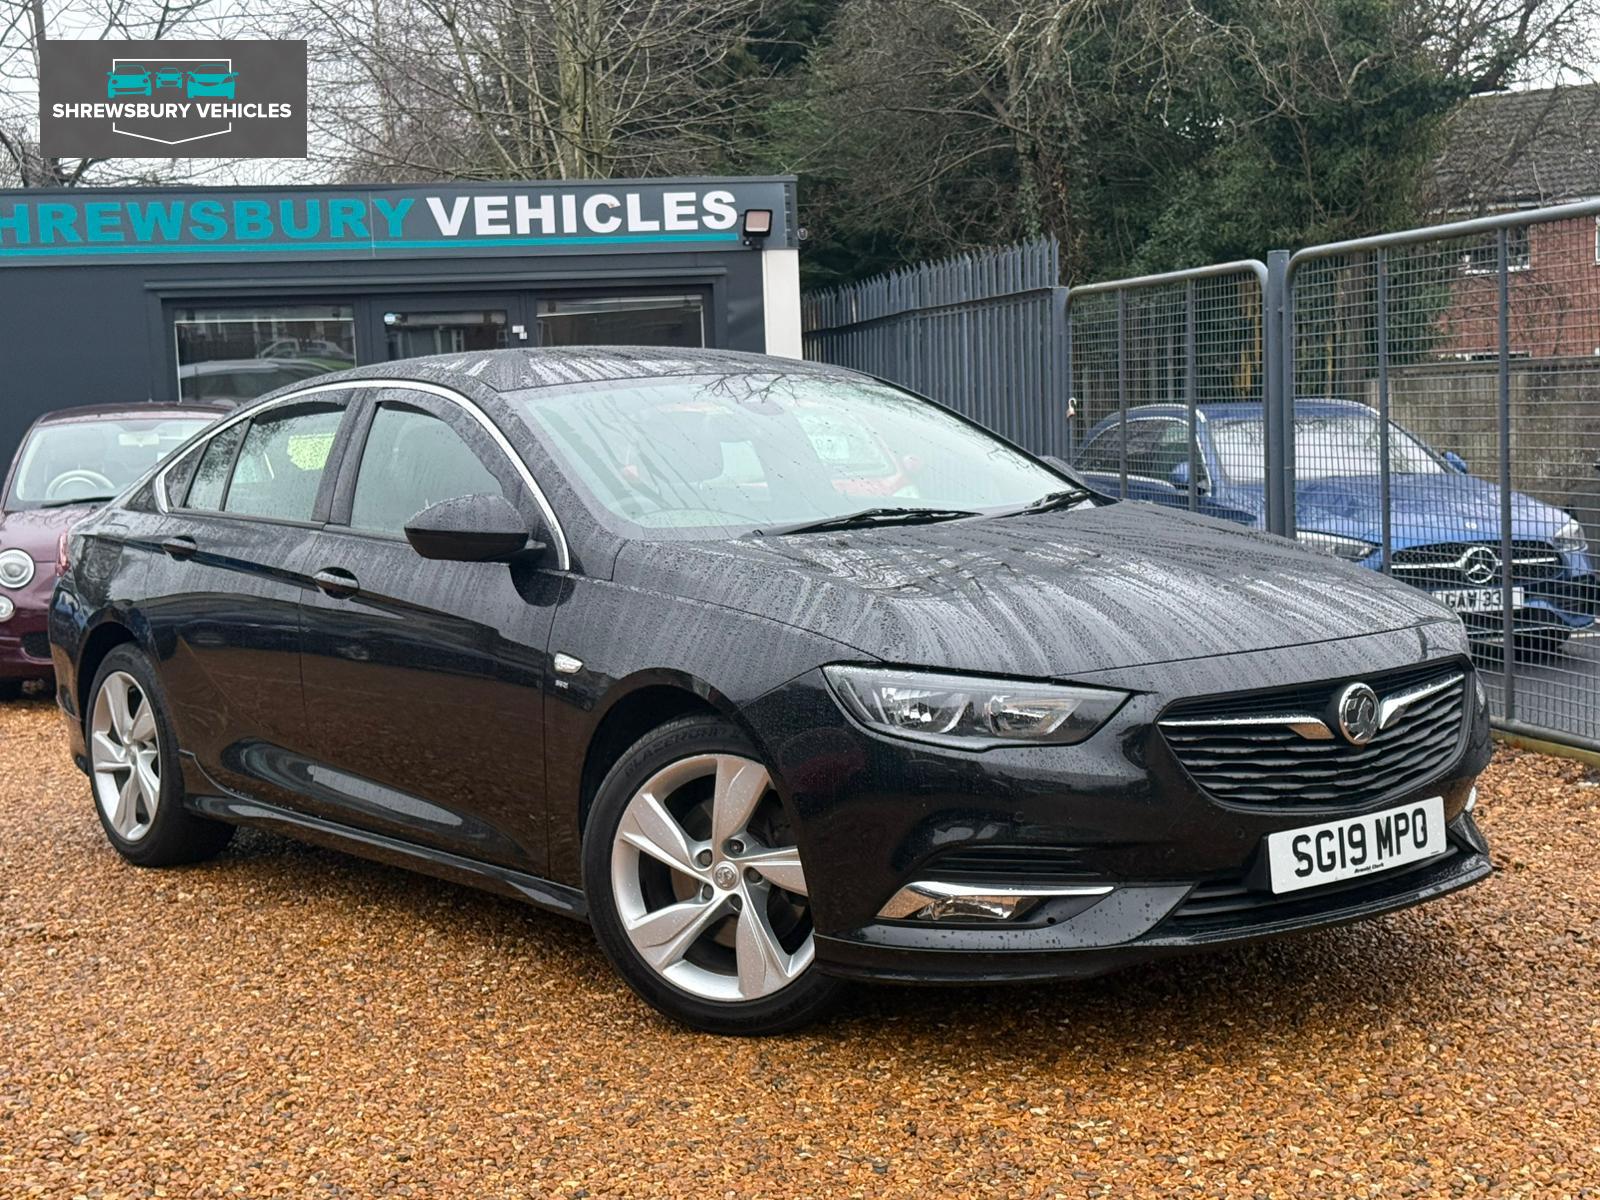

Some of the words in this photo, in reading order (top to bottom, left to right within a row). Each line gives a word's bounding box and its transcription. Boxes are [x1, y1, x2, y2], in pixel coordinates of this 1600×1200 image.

[426, 190, 738, 236] VEHICLES
[1292, 823, 1367, 878] SG19
[1375, 807, 1428, 860] MPO
